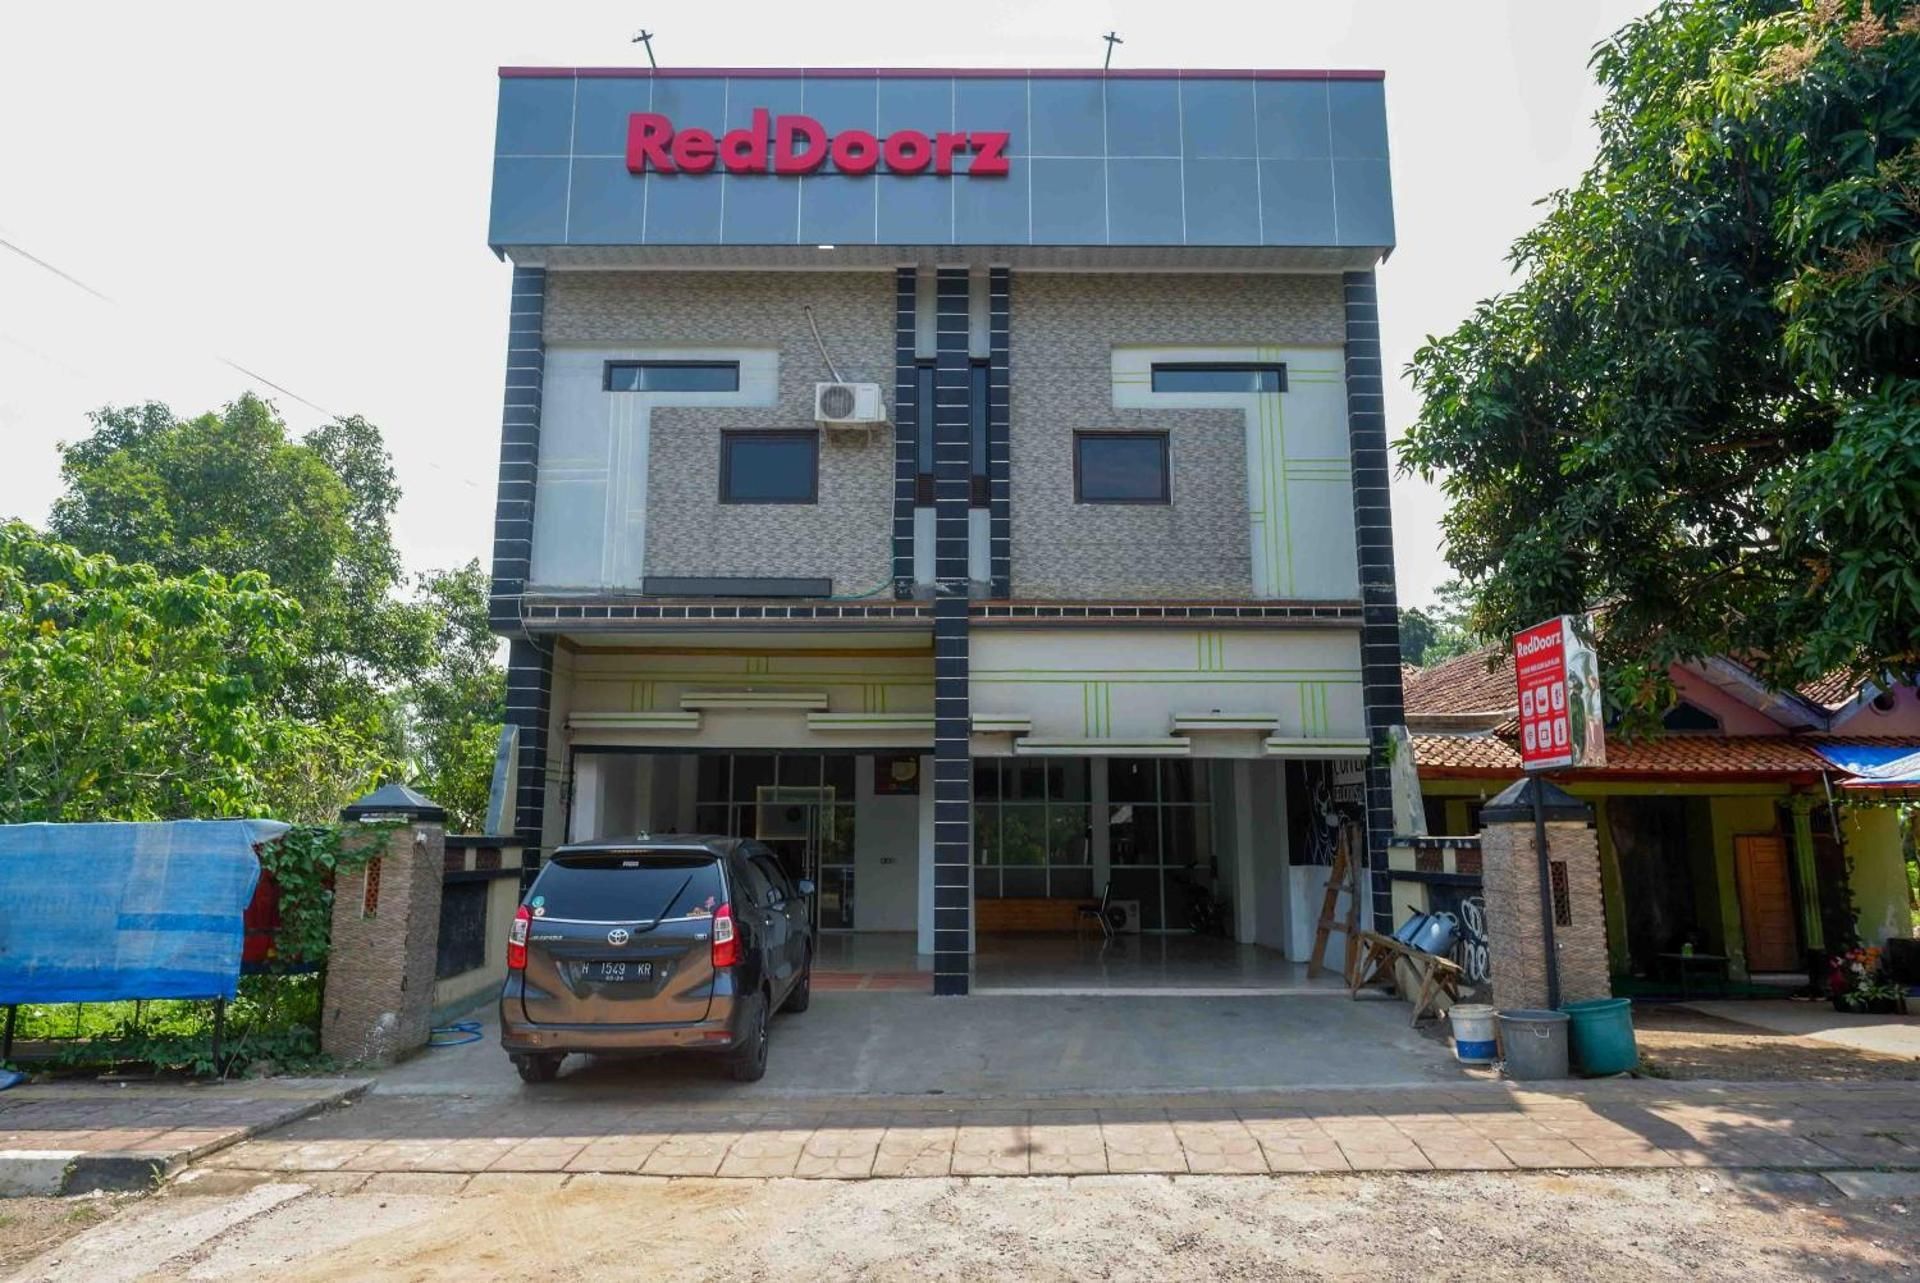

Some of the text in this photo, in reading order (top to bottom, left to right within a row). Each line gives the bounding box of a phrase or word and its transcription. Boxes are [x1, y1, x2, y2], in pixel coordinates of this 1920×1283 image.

[626, 108, 1010, 175] RedDoorz
[1517, 632, 1561, 657] RedDoorz
[581, 962, 651, 976] H 1549 KR
